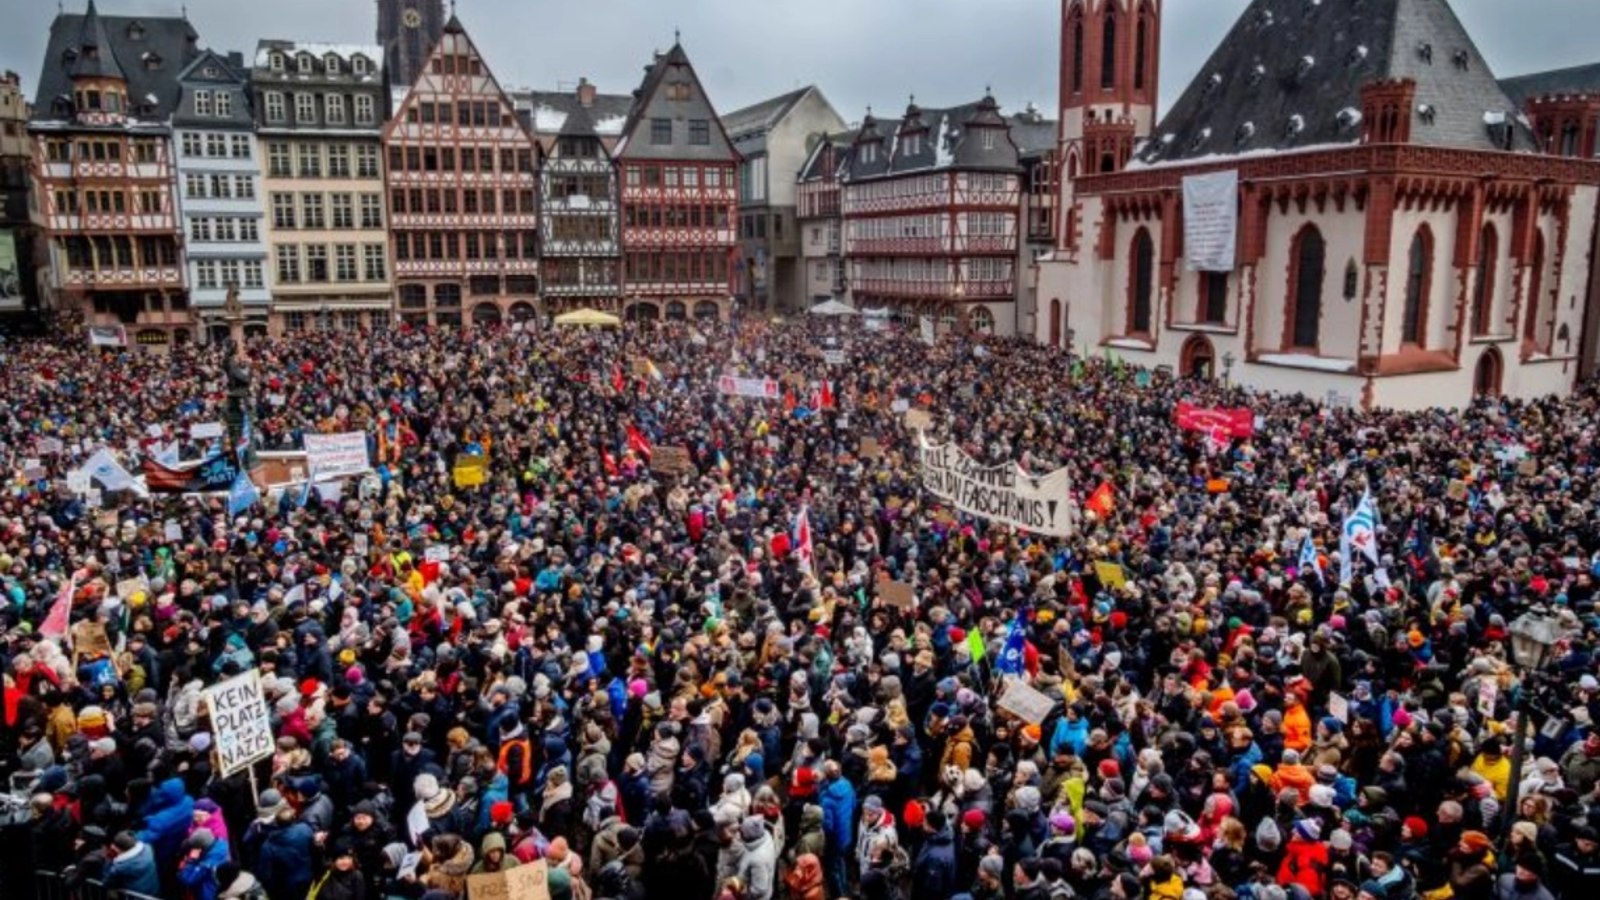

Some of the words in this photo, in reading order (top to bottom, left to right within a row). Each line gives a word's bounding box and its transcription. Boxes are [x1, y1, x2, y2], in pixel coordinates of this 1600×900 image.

[214, 681, 258, 711] KEIN
[216, 701, 265, 737] PLATZ
[222, 730, 271, 769] NAZIS
